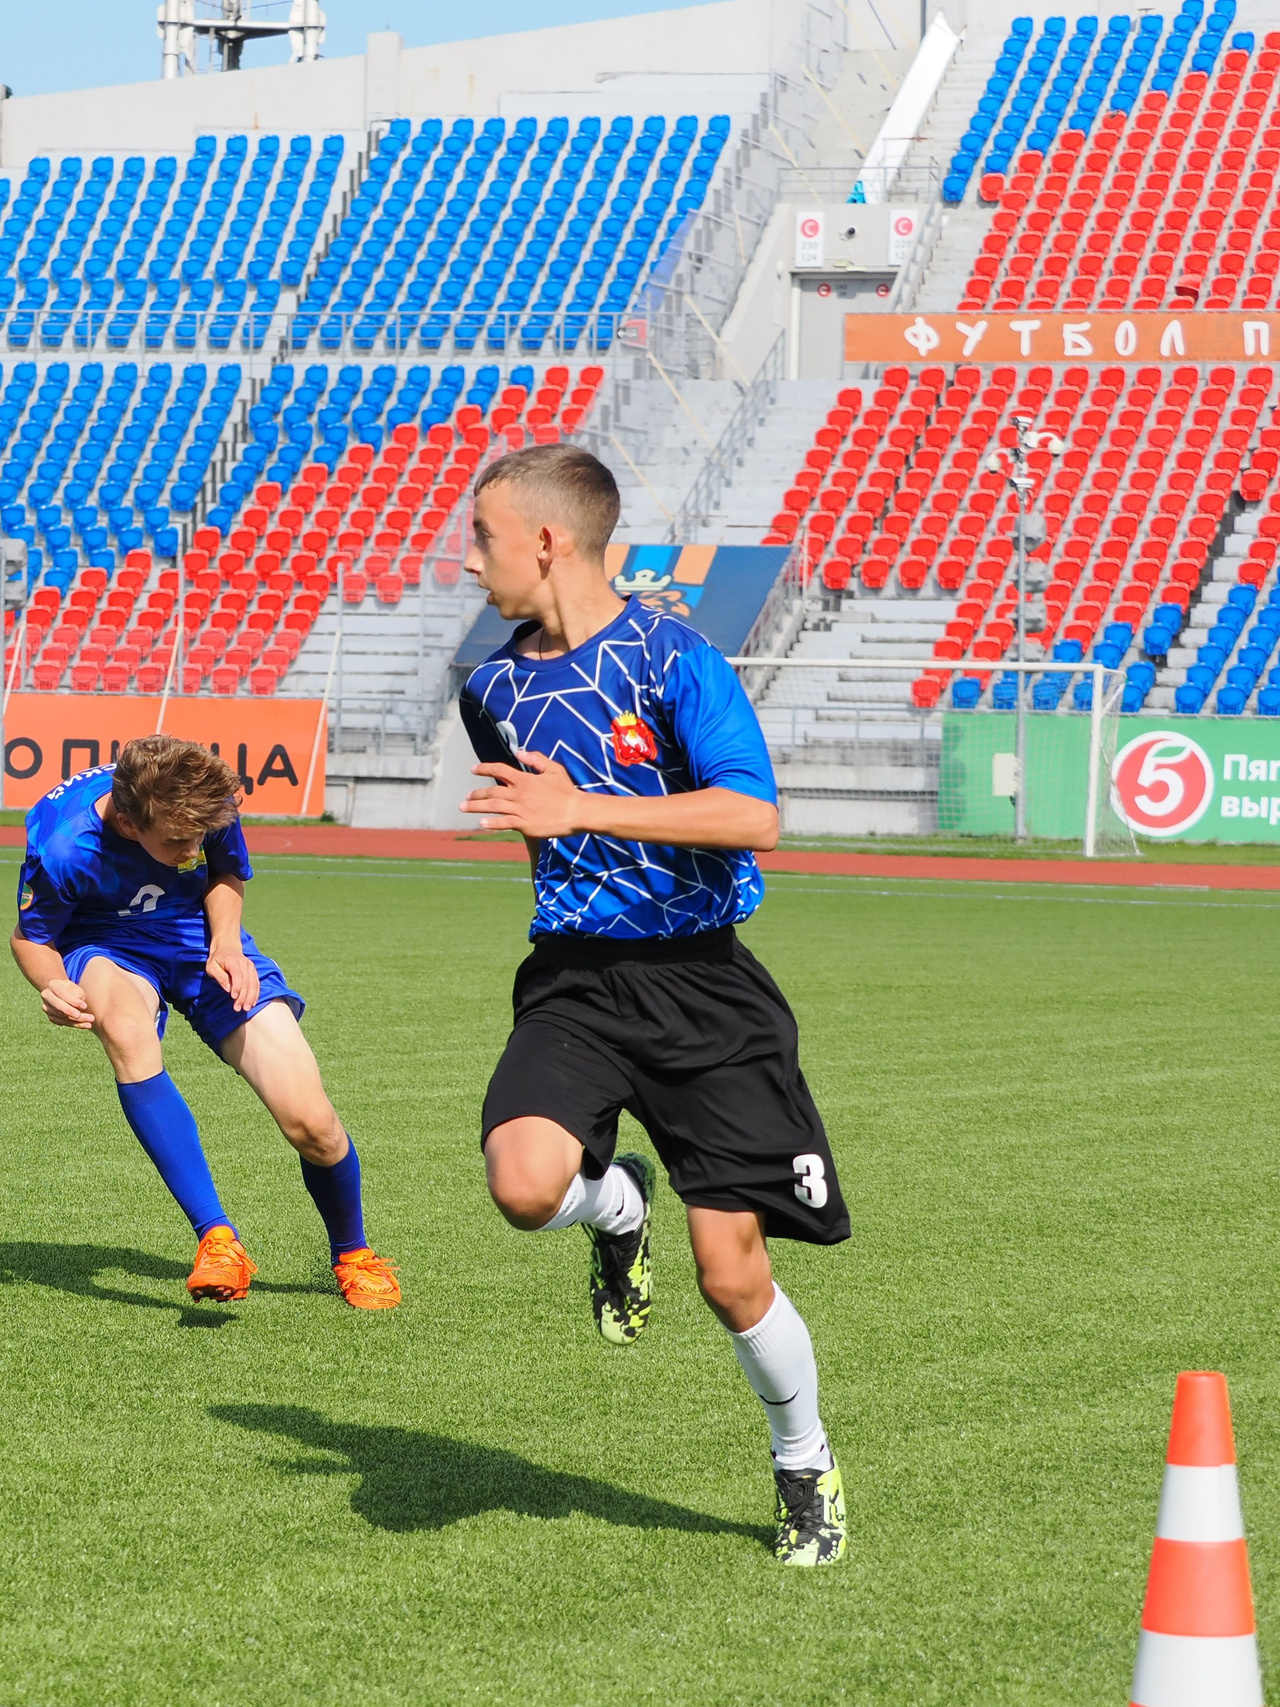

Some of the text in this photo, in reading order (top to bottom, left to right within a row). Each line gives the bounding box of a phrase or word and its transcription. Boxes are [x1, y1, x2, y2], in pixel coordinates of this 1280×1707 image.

[904, 317, 1185, 357] ФУТБОЛ
[61, 738, 299, 796] ПЦА
[1134, 738, 1193, 817] 5
[792, 1153, 828, 1209] 3
